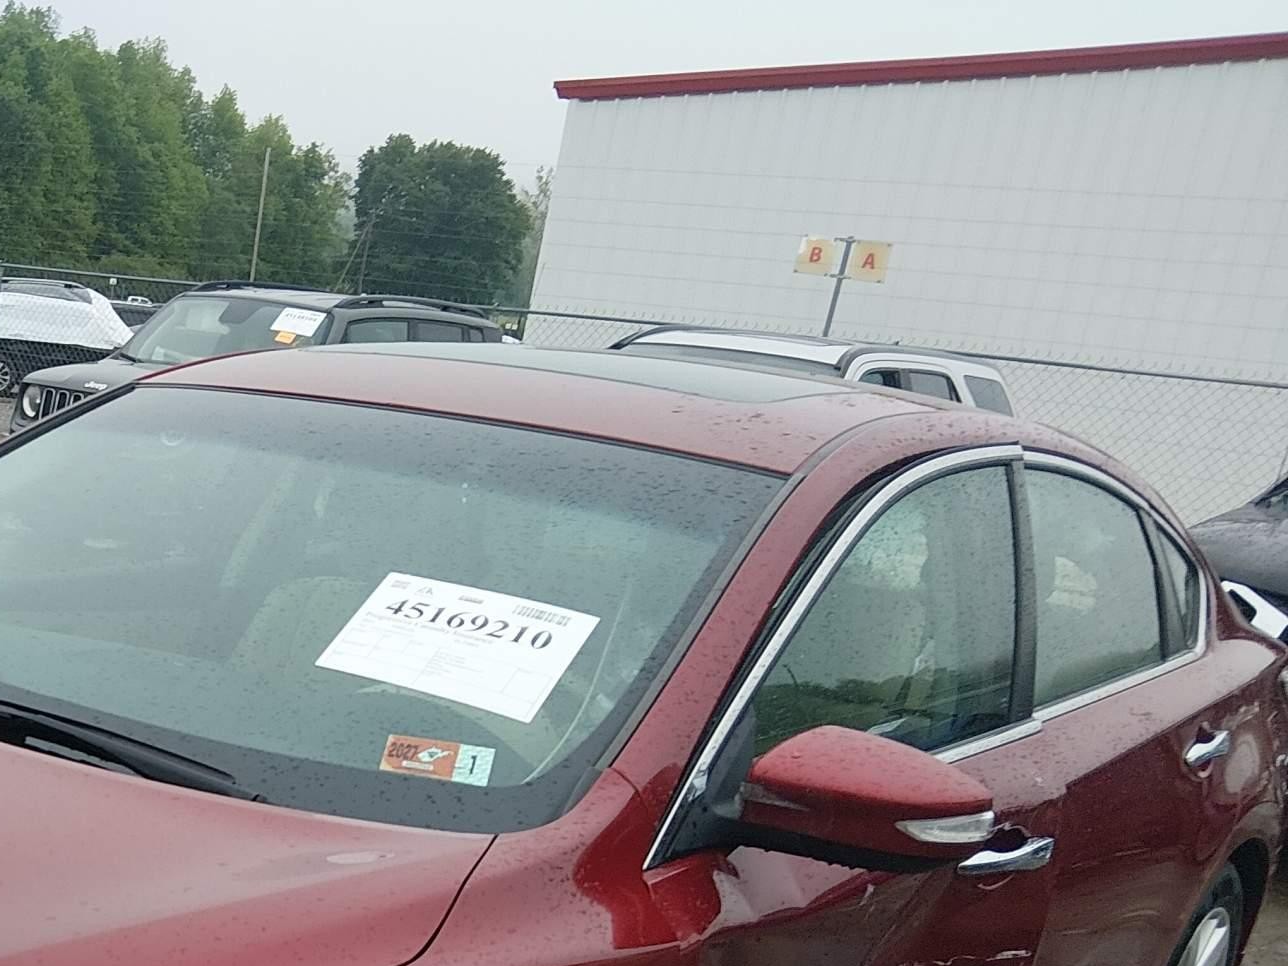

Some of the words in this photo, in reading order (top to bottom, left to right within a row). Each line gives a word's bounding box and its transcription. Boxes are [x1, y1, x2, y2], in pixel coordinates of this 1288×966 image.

[809, 246, 823, 263] B
[861, 252, 875, 270] A
[385, 599, 553, 650] 45169210
[469, 754, 478, 776] 1
